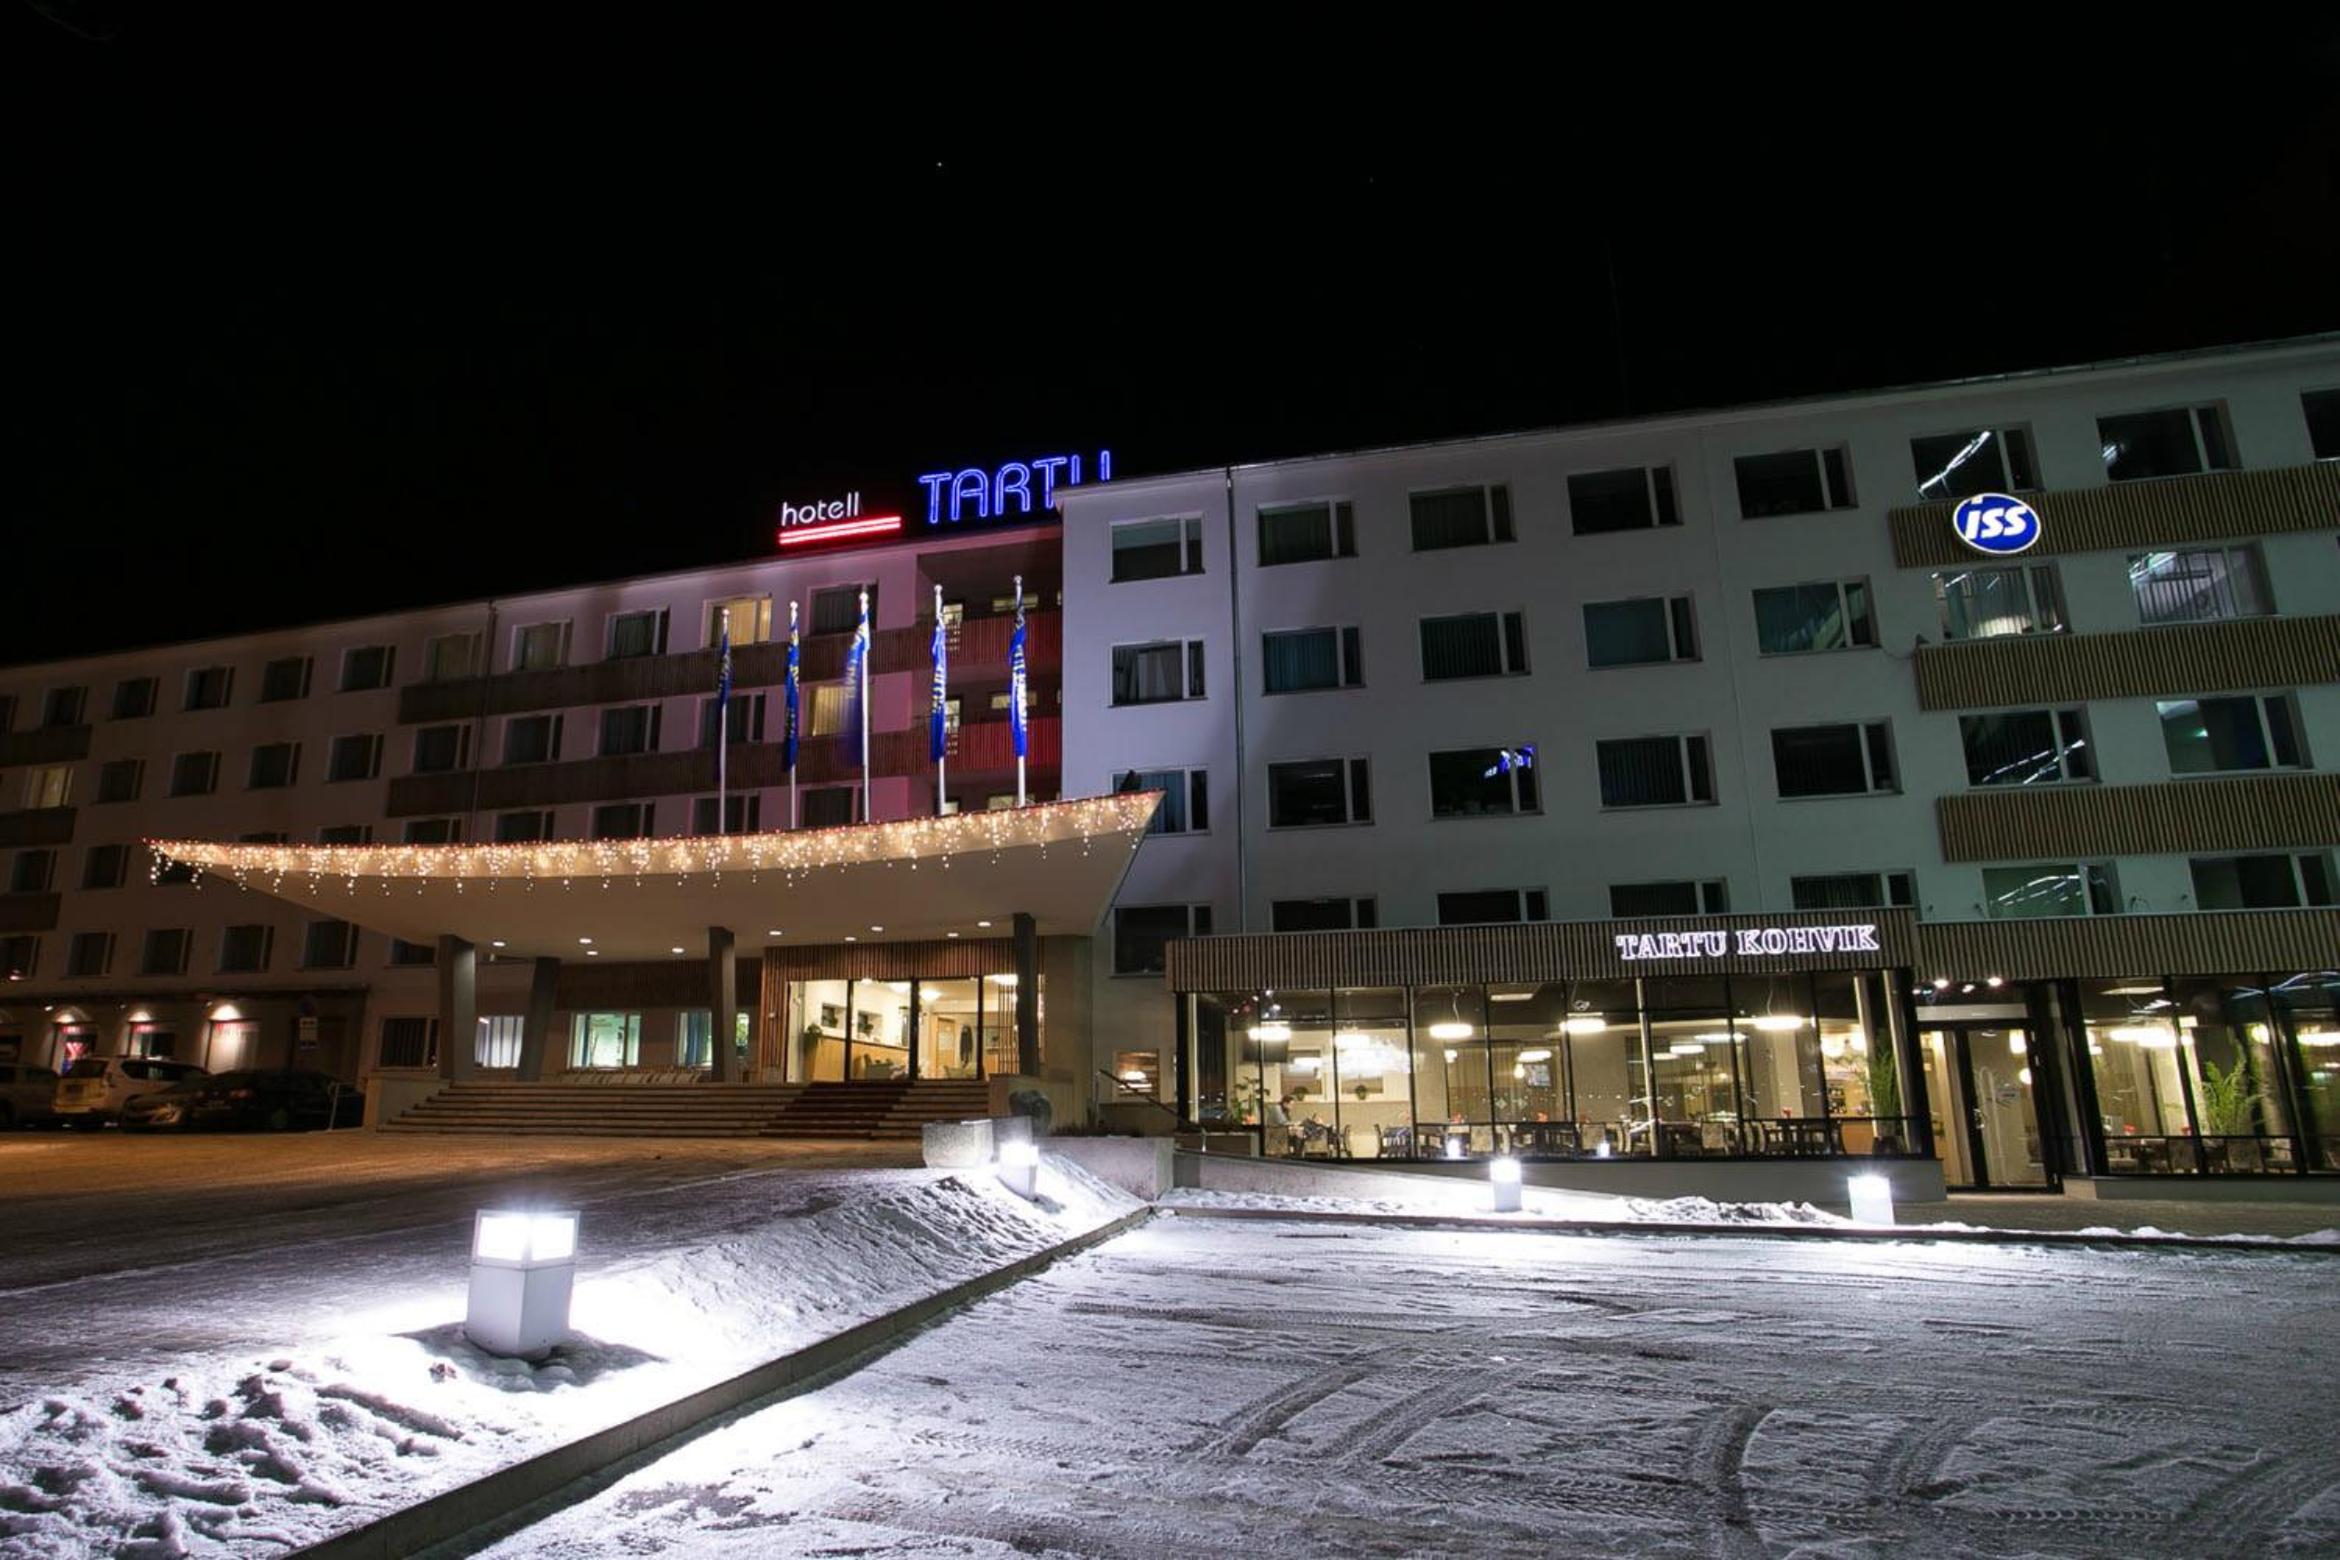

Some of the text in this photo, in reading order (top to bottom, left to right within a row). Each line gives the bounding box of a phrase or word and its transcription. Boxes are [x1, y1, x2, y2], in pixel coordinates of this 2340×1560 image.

[780, 490, 861, 528] hotell
[1615, 924, 1880, 961] TARTU KOHVIK
